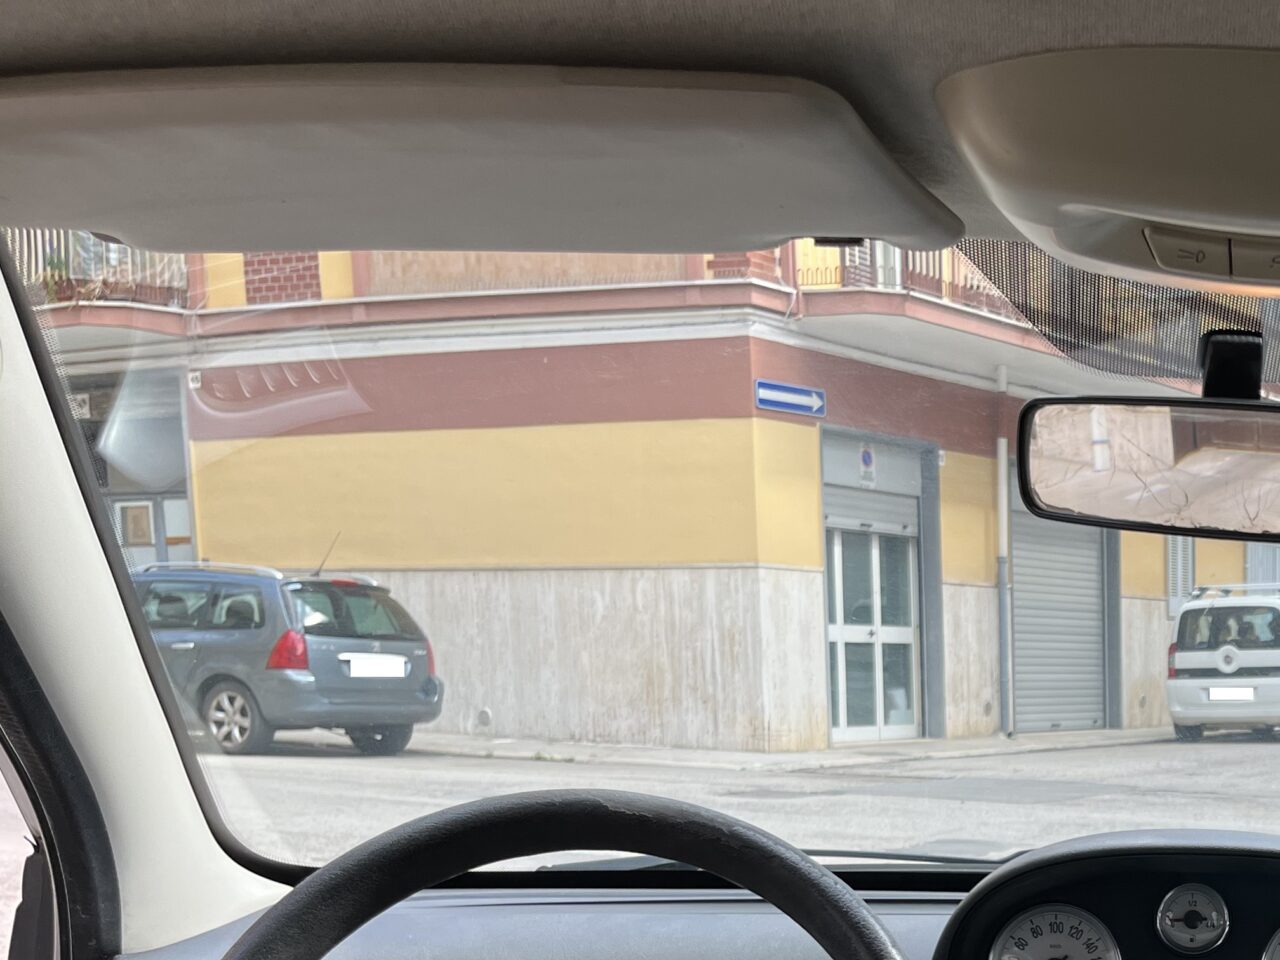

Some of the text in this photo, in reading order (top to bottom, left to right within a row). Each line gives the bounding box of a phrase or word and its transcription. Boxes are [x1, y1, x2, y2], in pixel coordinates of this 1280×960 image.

[1030, 925, 1043, 939] 80
[1048, 921, 1064, 933] 100
[1068, 925, 1084, 940] 120
[1014, 937, 1029, 951] 60
[1082, 938, 1098, 954] 140
